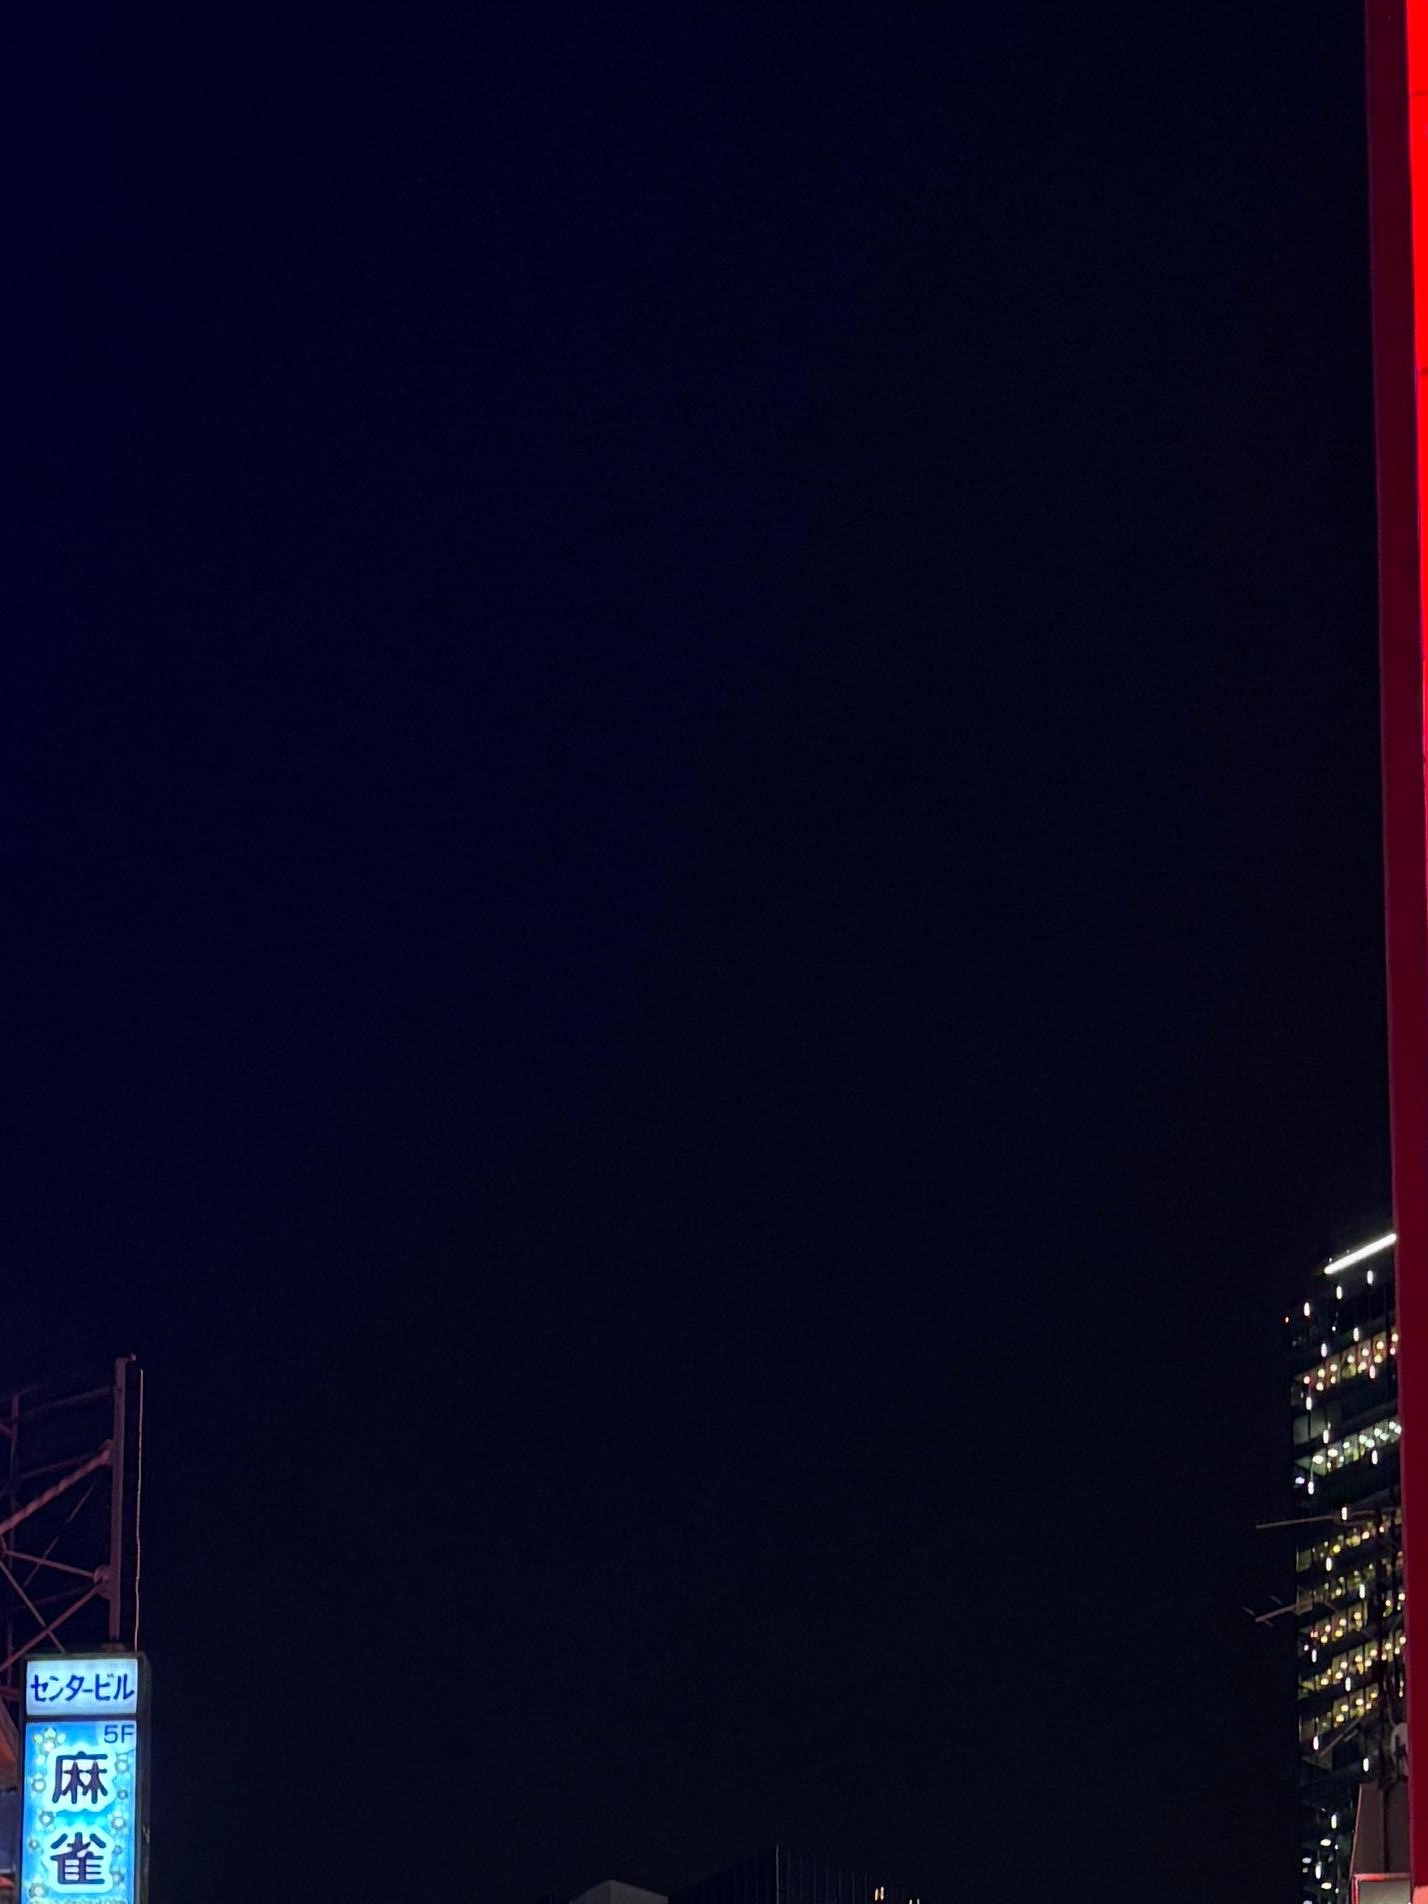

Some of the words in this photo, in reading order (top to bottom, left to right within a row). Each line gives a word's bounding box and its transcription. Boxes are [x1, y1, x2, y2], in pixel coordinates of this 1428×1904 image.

[30, 1673, 135, 1703] センタービル
[102, 1724, 135, 1744] 5F
[49, 1750, 109, 1886] 麻雀
